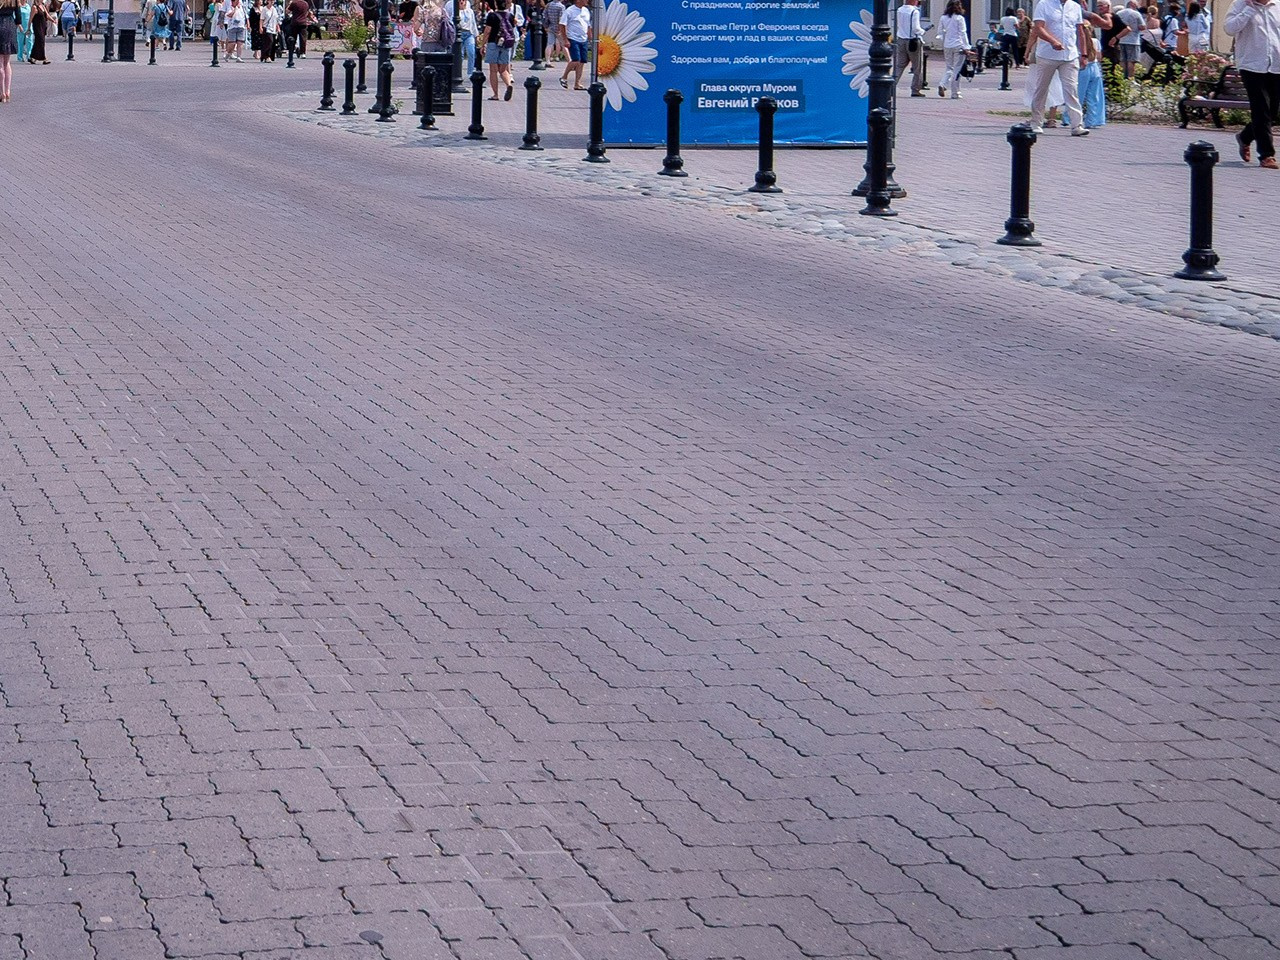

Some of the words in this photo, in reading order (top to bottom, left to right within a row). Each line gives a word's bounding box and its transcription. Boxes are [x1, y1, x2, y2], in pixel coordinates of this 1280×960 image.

[681, 0, 689, 9] С
[690, 2, 744, 10] праздником,
[745, 2, 780, 10] дорогие
[781, 1, 820, 9] земляки!
[671, 22, 696, 32] Пусть
[728, 23, 750, 32] Петр
[757, 23, 800, 32] Феврония
[801, 24, 829, 32] всегда
[671, 33, 717, 43] оберегают
[717, 35, 736, 43] мир
[795, 34, 828, 42] семьях!
[670, 55, 712, 65] Здоровья
[713, 57, 732, 65] вам,
[733, 55, 760, 65] добра
[767, 55, 828, 65] благополучия!
[700, 83, 728, 92] Глава
[728, 84, 761, 94] округа
[762, 83, 797, 94] Муром
[697, 96, 749, 108] Евгений
[751, 97, 800, 108] Рков
